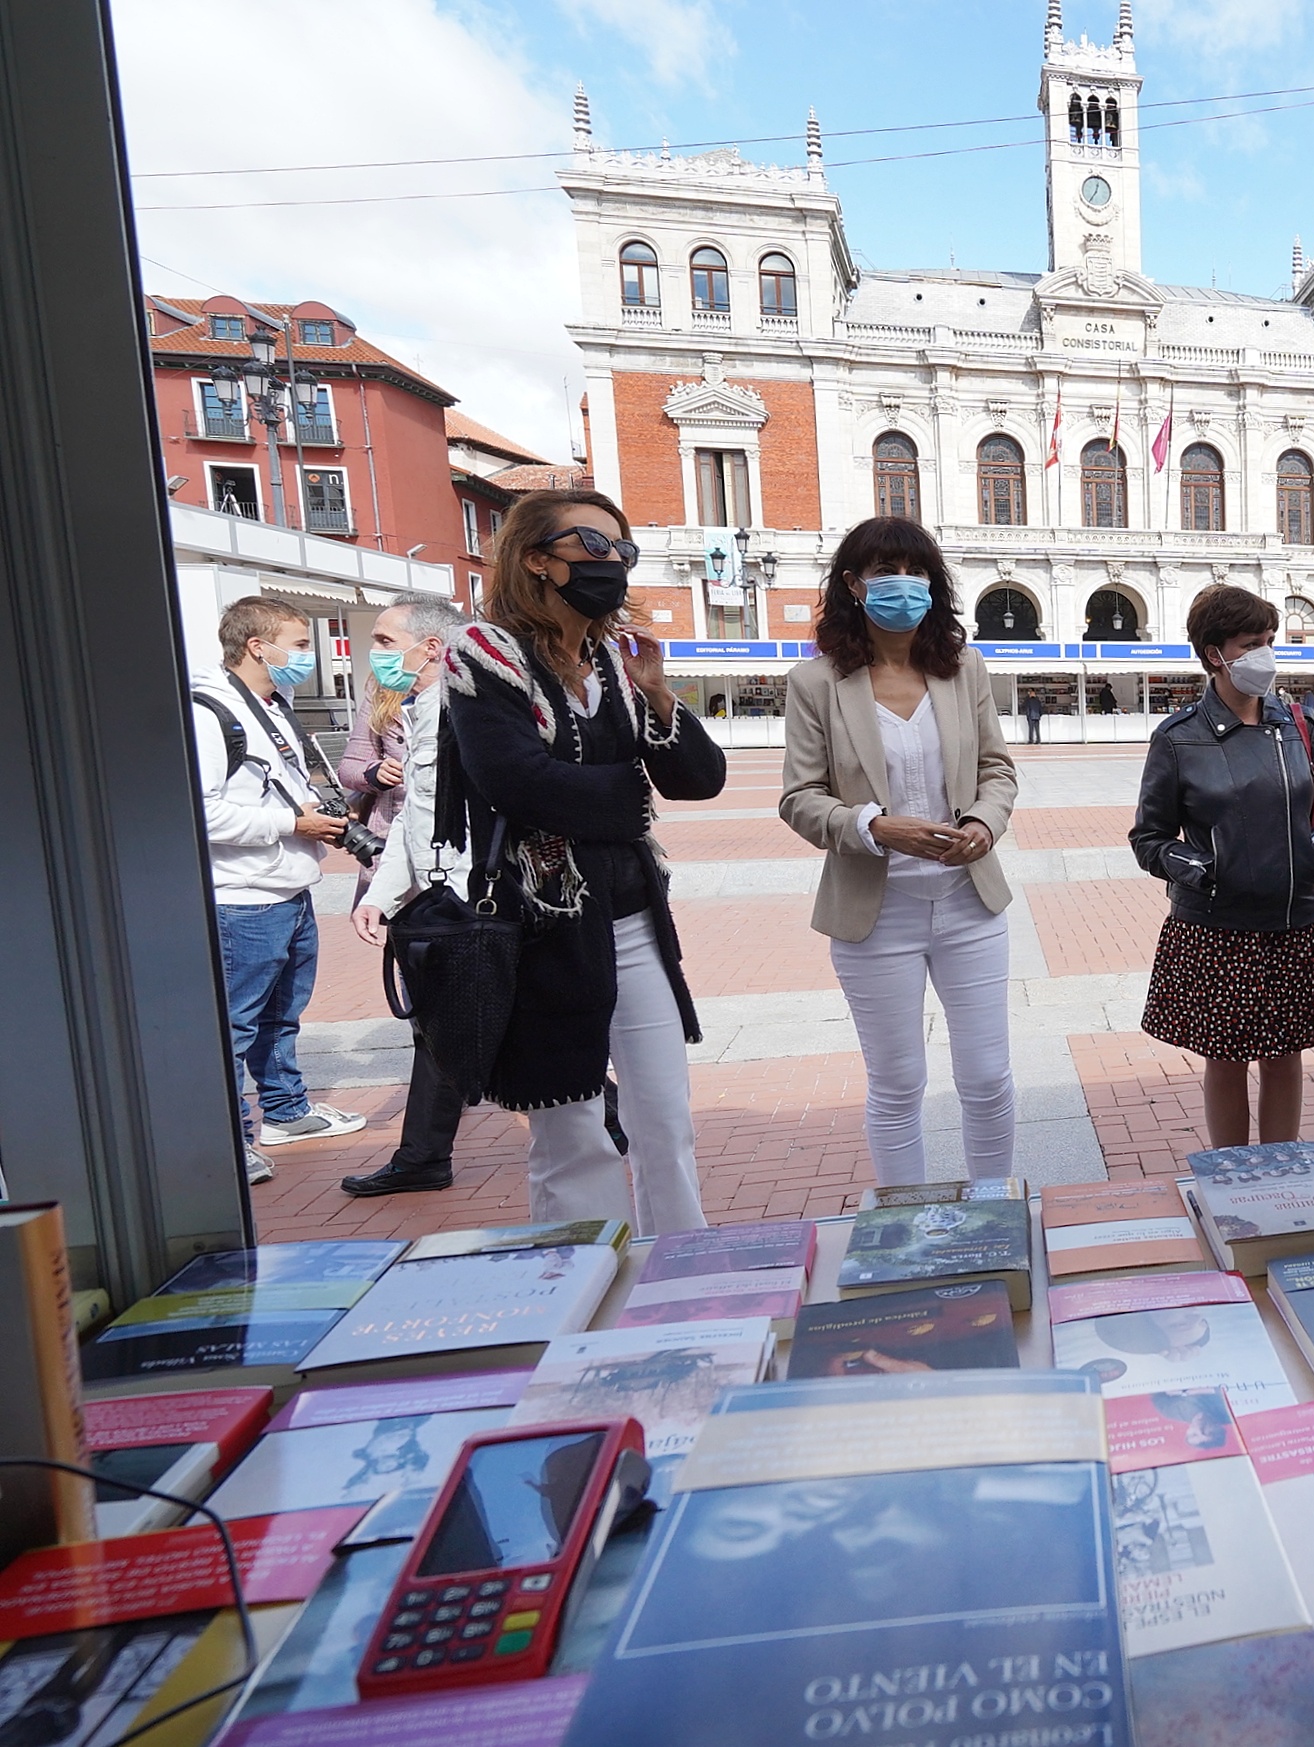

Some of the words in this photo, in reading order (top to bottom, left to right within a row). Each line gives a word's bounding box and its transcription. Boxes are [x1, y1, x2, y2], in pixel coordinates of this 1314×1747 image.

[1085, 322, 1116, 335] CASA
[1062, 337, 1139, 352] CONSISTORIAL
[1130, 647, 1163, 656] AUTOEDICIÓN
[1229, 1191, 1302, 1208] Oscuras
[1294, 1280, 1310, 1289] TE
[351, 1304, 549, 1338] MONFORTE
[866, 1316, 884, 1326] de
[883, 1310, 929, 1324] Fábrica
[381, 1320, 499, 1345] REYES
[806, 1317, 867, 1333] prodigios
[194, 1340, 269, 1355] MALAS
[1138, 1436, 1166, 1449] LOS
[1299, 1456, 1313, 1465] de
[1190, 1603, 1211, 1618] EL
[986, 1653, 1041, 1683] EL
[1053, 1650, 1110, 1680] EN
[803, 1664, 979, 1706] VIENTO
[971, 1680, 1113, 1720] COMO
[804, 1694, 959, 1741] POLVO
